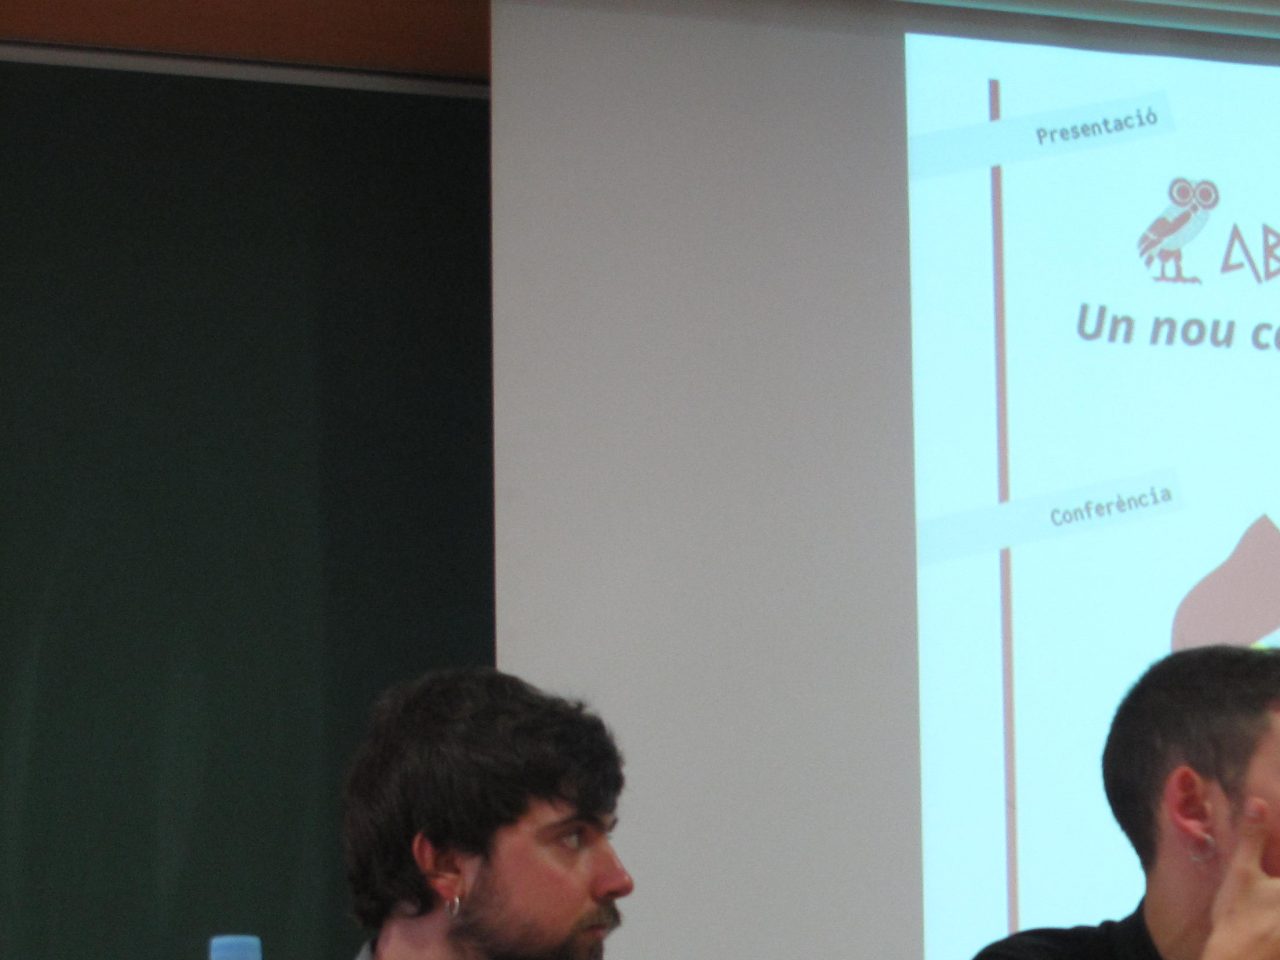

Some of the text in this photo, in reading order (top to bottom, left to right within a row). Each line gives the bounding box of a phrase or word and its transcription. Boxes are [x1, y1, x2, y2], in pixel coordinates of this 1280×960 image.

[1036, 106, 1159, 146] Presentació
[1076, 303, 1135, 344] Un
[1149, 316, 1235, 349] nou
[1050, 486, 1172, 526] Conferència
